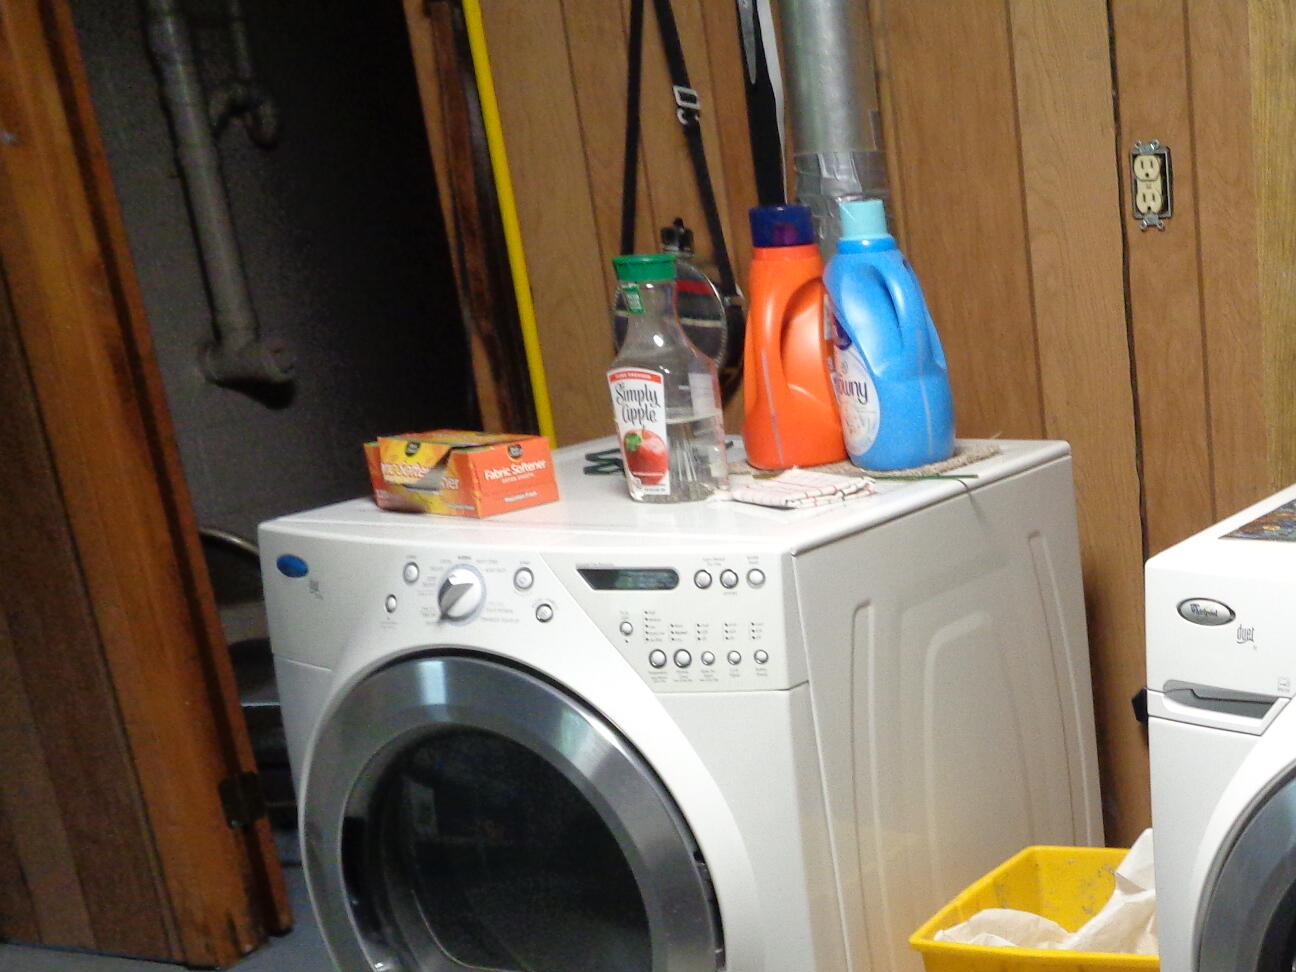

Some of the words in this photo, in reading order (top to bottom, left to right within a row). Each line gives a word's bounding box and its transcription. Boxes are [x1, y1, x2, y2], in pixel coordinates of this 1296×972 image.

[615, 383, 661, 408] Simply
[484, 466, 512, 480] Fabric
[510, 461, 546, 475] Softener
